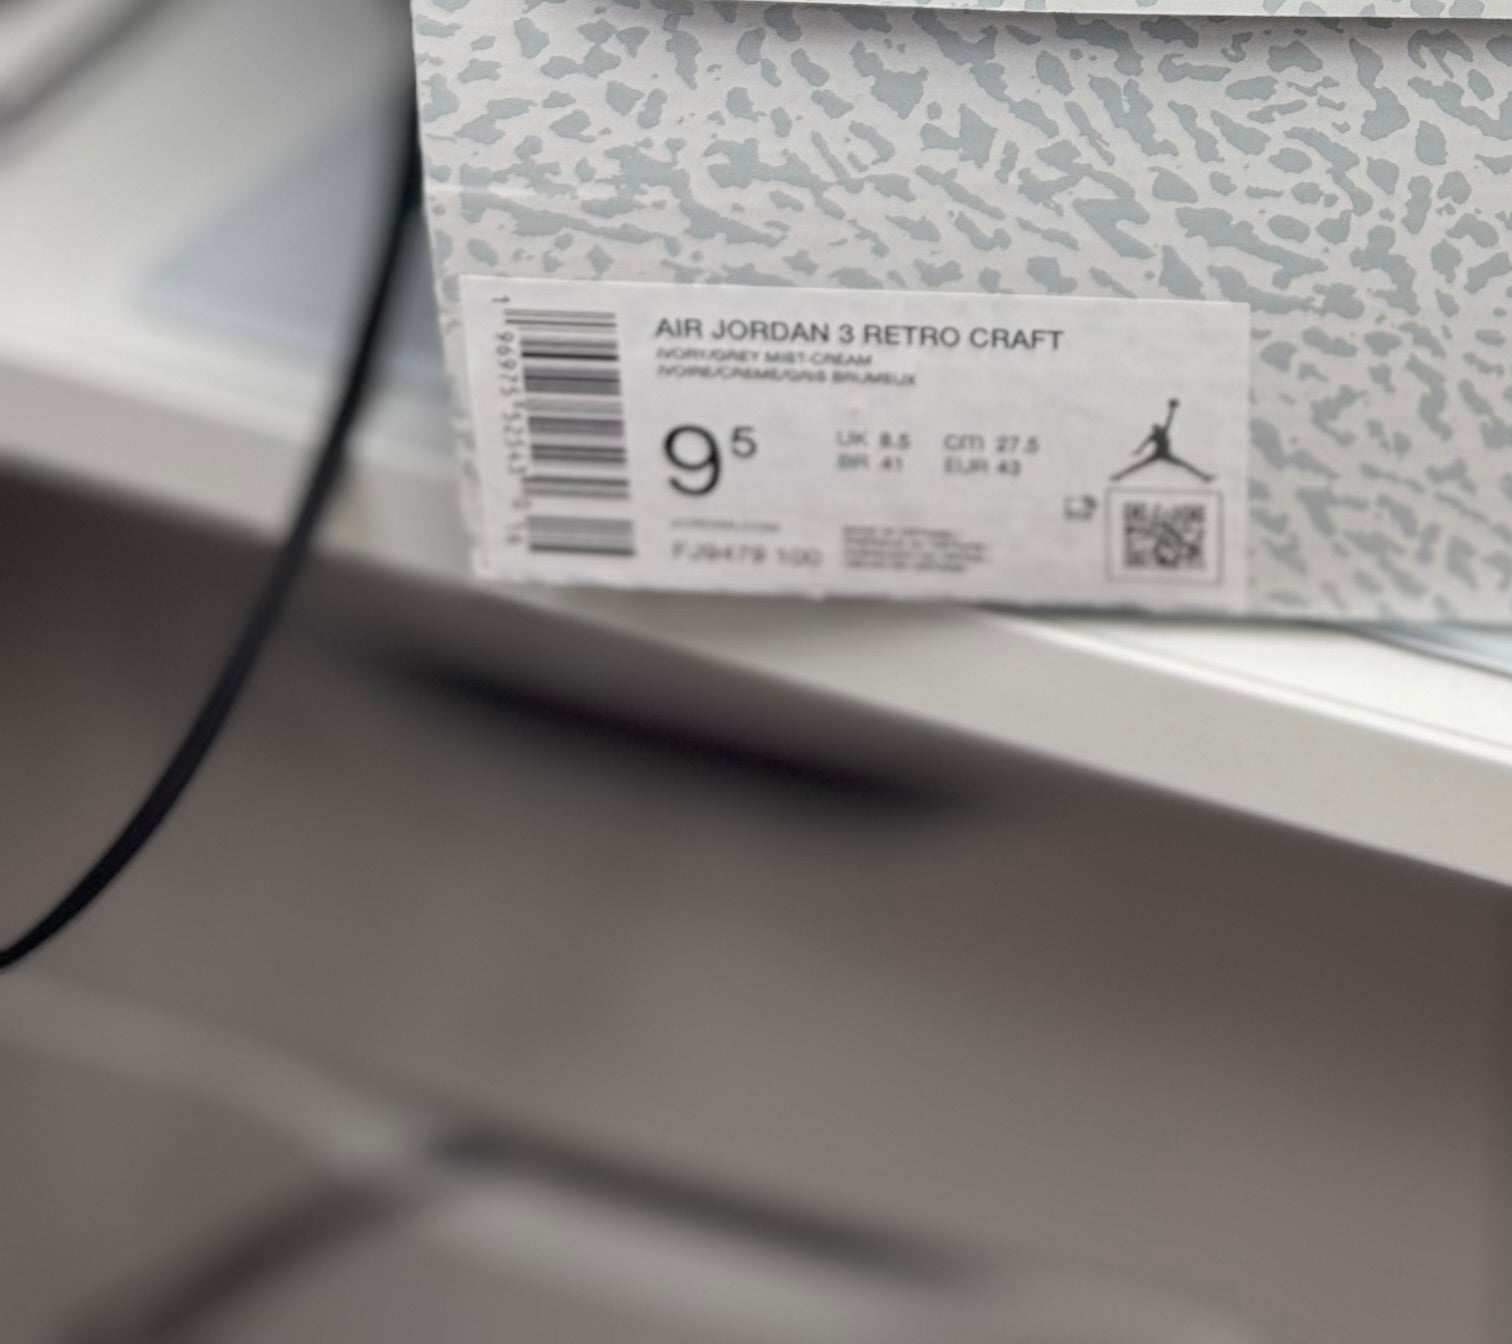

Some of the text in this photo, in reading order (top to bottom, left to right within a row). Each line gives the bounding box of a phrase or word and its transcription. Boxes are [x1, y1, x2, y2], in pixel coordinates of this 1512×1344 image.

[654, 317, 1065, 351] AIR JORDAN 3 RETRO CRAFT
[835, 430, 868, 449] UK
